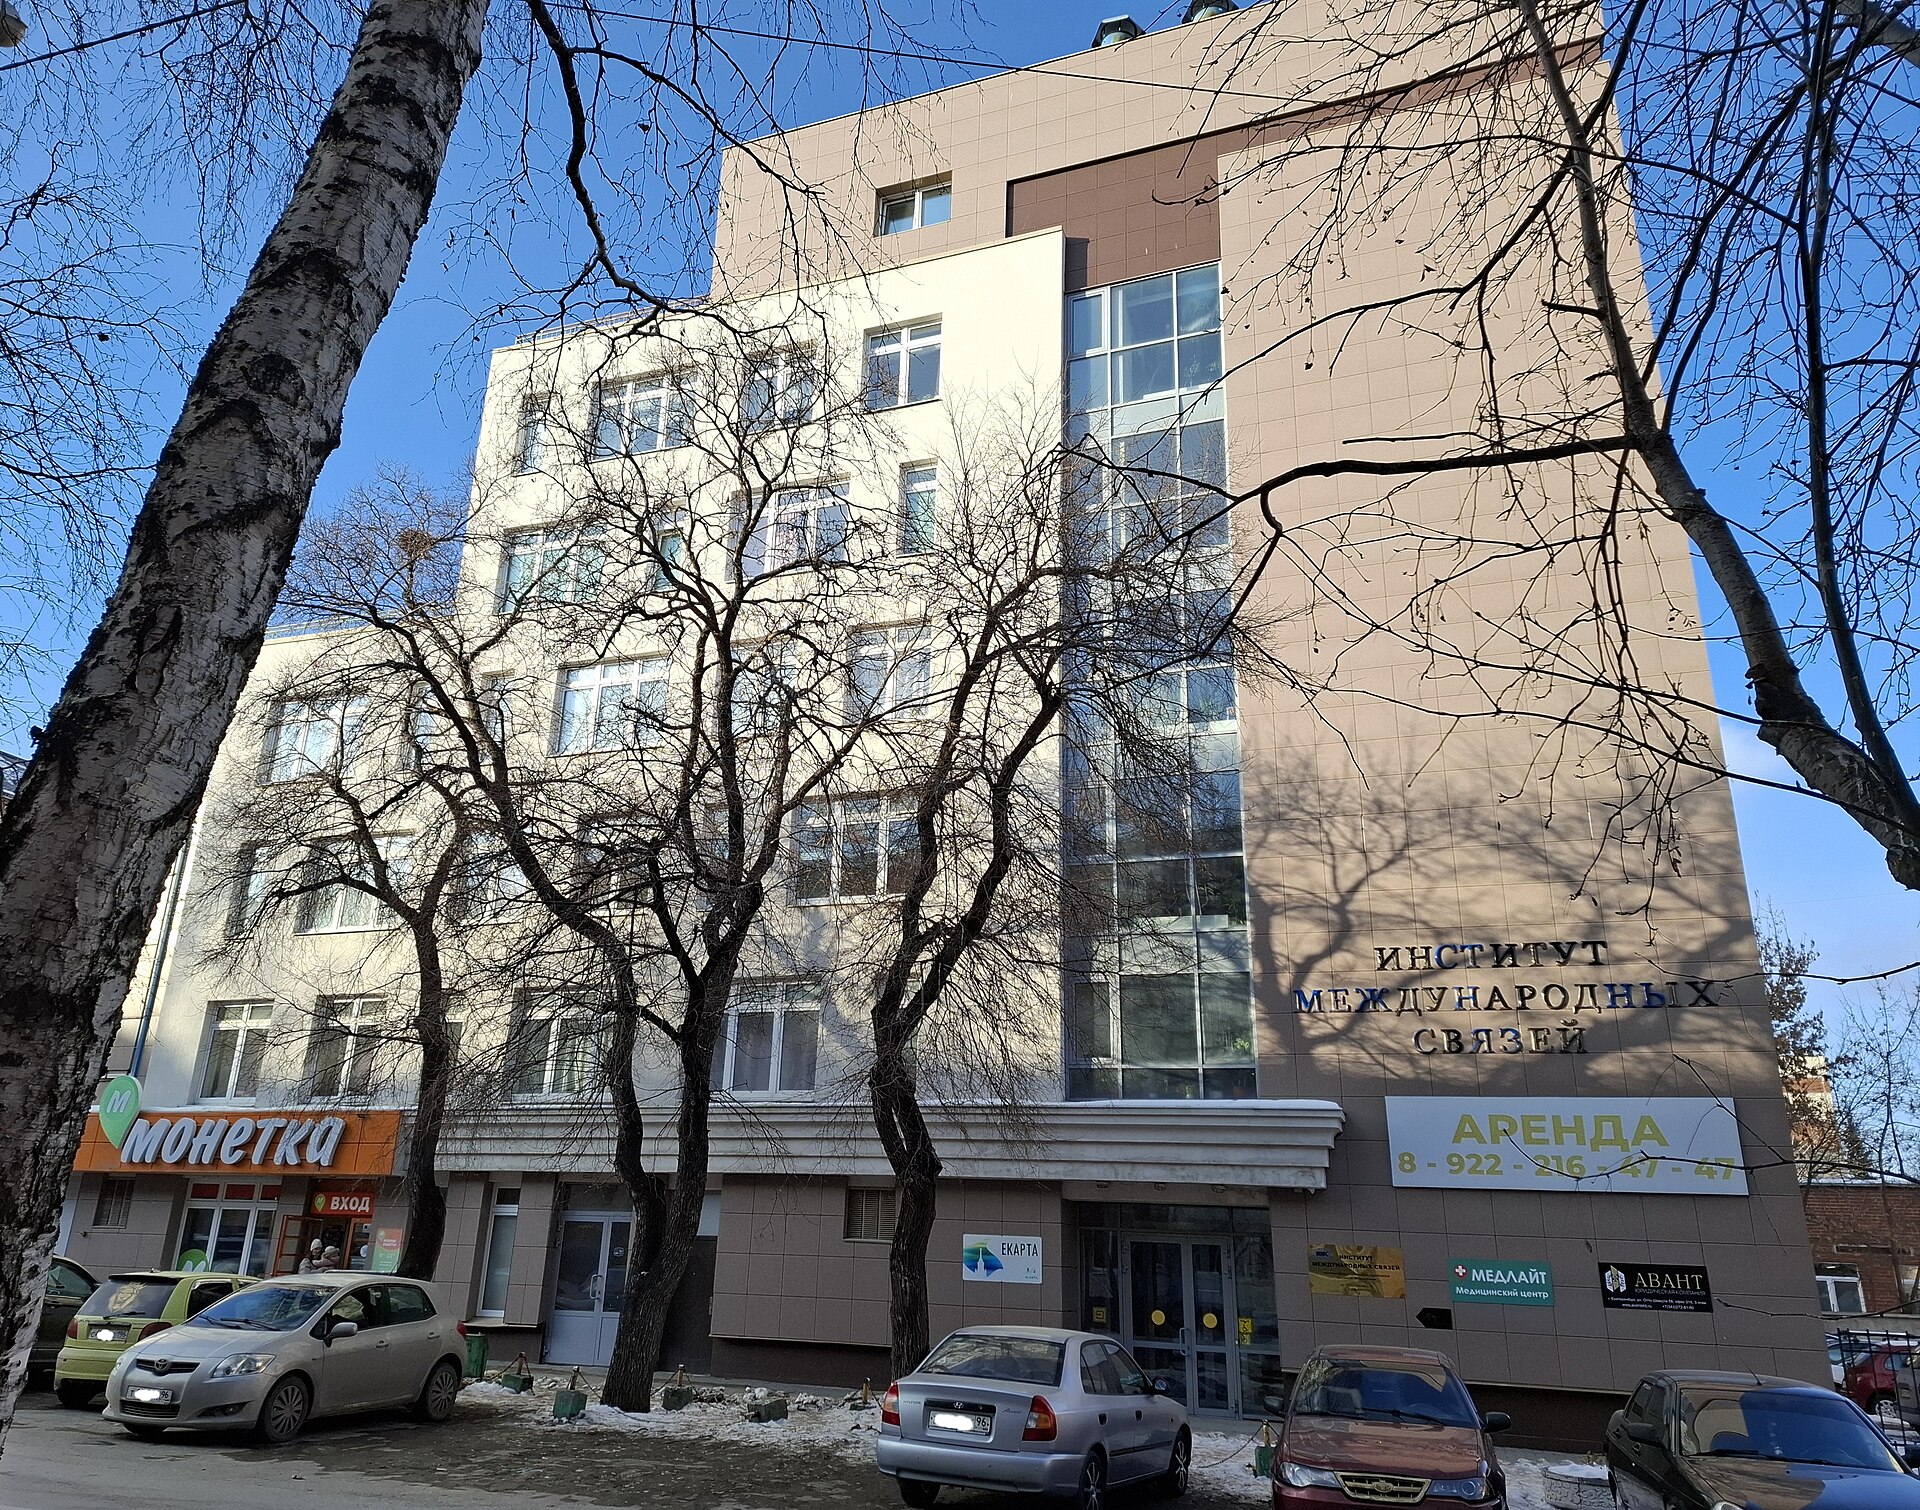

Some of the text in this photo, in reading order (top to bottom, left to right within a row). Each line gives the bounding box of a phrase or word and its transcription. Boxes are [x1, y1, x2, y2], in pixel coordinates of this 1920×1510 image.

[1373, 940, 1608, 971] ИНСТИТУТ
[1293, 980, 1720, 1016] МЕЖДУНАРОДНЫХ
[1412, 1018, 1589, 1054] СВЯЗЕЙ
[1452, 1113, 1670, 1152] АРЕНДА
[1446, 1153, 1504, 1176] 922
[1534, 1154, 1586, 1178] 216
[330, 1196, 370, 1213] ВХОД
[1001, 1242, 1039, 1257] ЕКАРТА
[1339, 1254, 1373, 1262] ИНСТИТУТ
[1311, 1261, 1401, 1272] МЕЖДУНАРОДНЫХ СВЯЗЕЙ
[1471, 1268, 1547, 1285] МЕДЛАЙТ
[1634, 1272, 1704, 1290] АВАНТ
[1455, 1286, 1549, 1300] Медицинский центр
